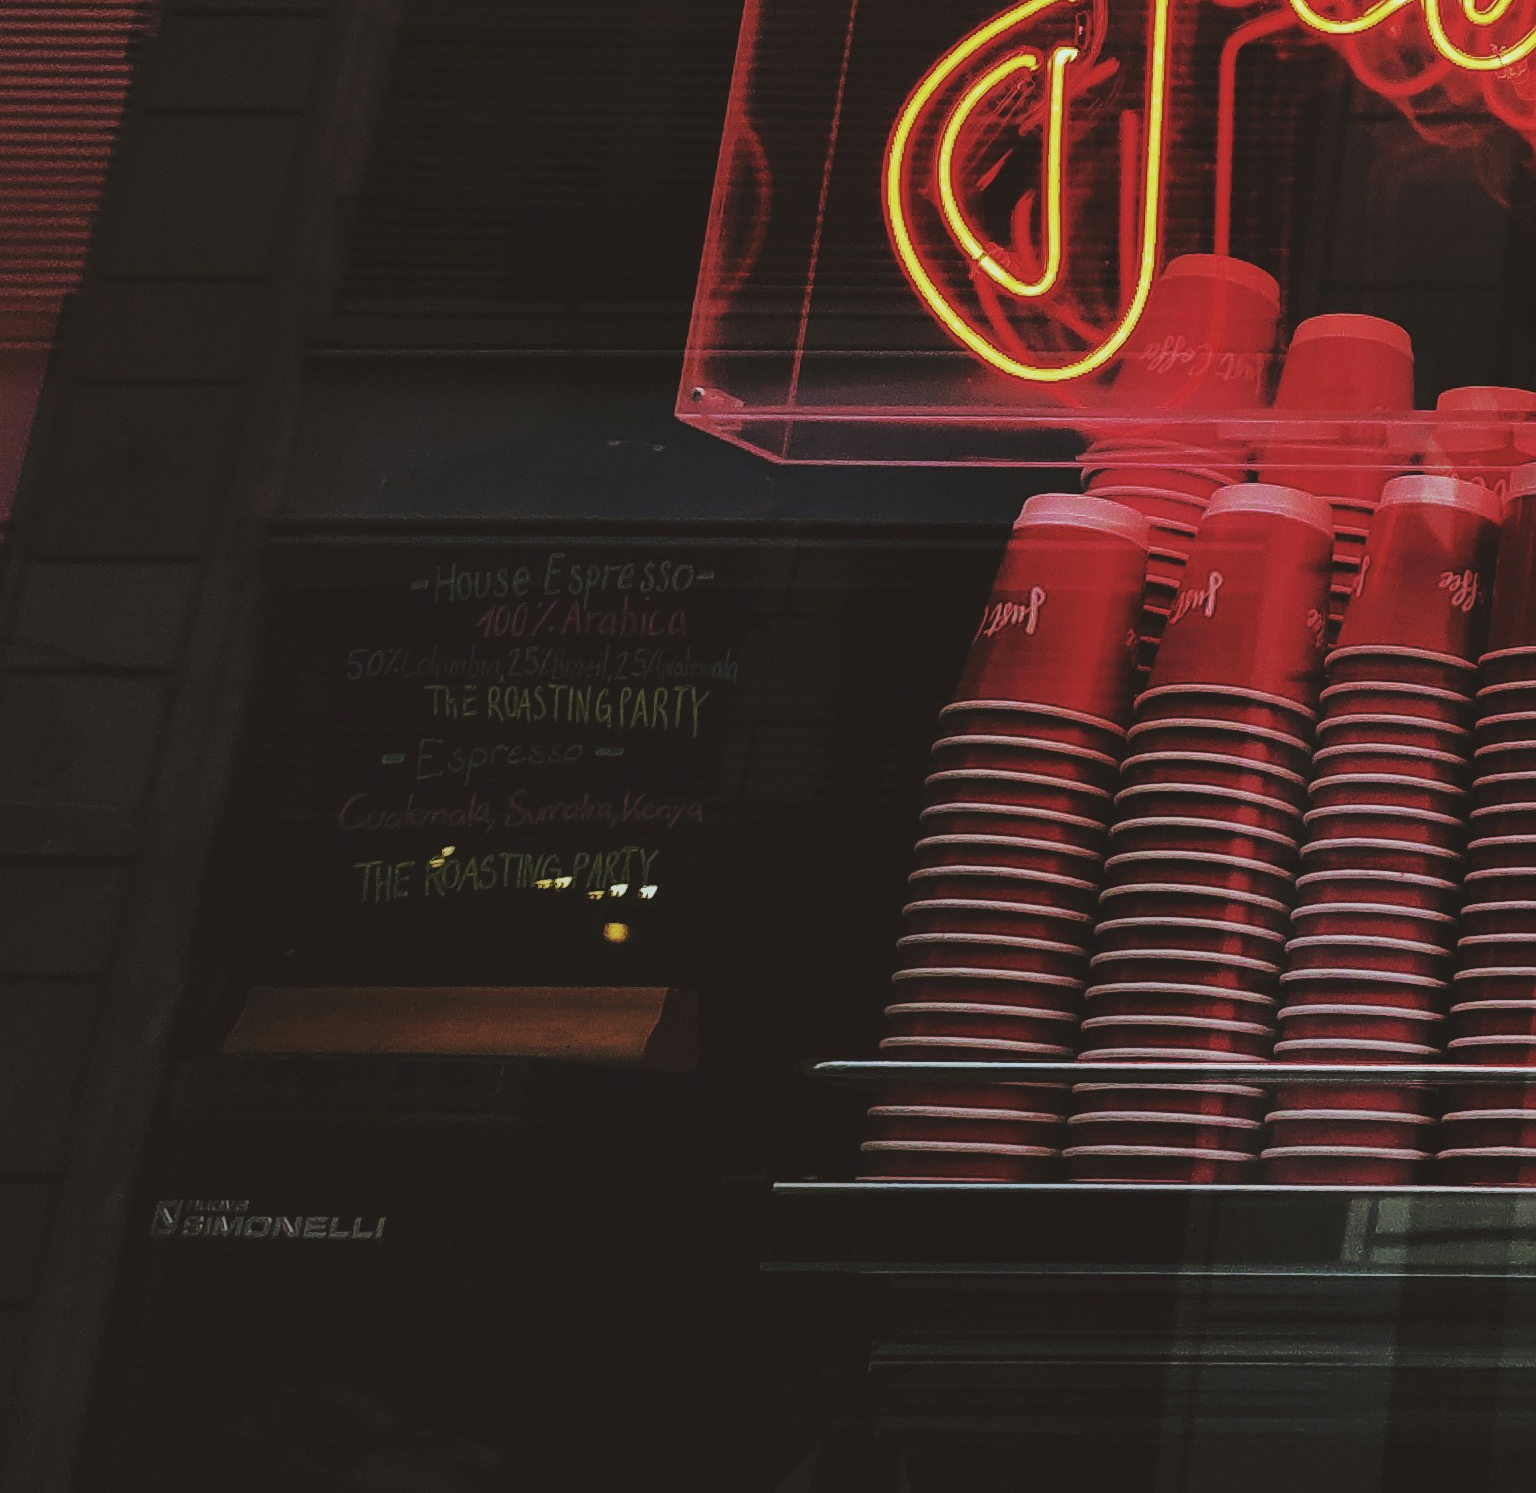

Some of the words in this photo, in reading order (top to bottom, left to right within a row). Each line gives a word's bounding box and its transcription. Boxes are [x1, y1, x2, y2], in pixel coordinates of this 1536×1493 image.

[985, 585, 1047, 637] Just
[1437, 569, 1479, 613] ffee
[476, 600, 557, 639] 100%
[560, 594, 688, 637] Arabica
[487, 683, 612, 729] ROASTING
[618, 684, 712, 739] PARTY
[416, 737, 584, 787] Espresso
[621, 788, 705, 829] Kenya
[353, 859, 417, 904] THE
[424, 849, 562, 898] ROASTING
[572, 845, 660, 896] PARTY
[181, 1215, 387, 1240] SIMONELLI
